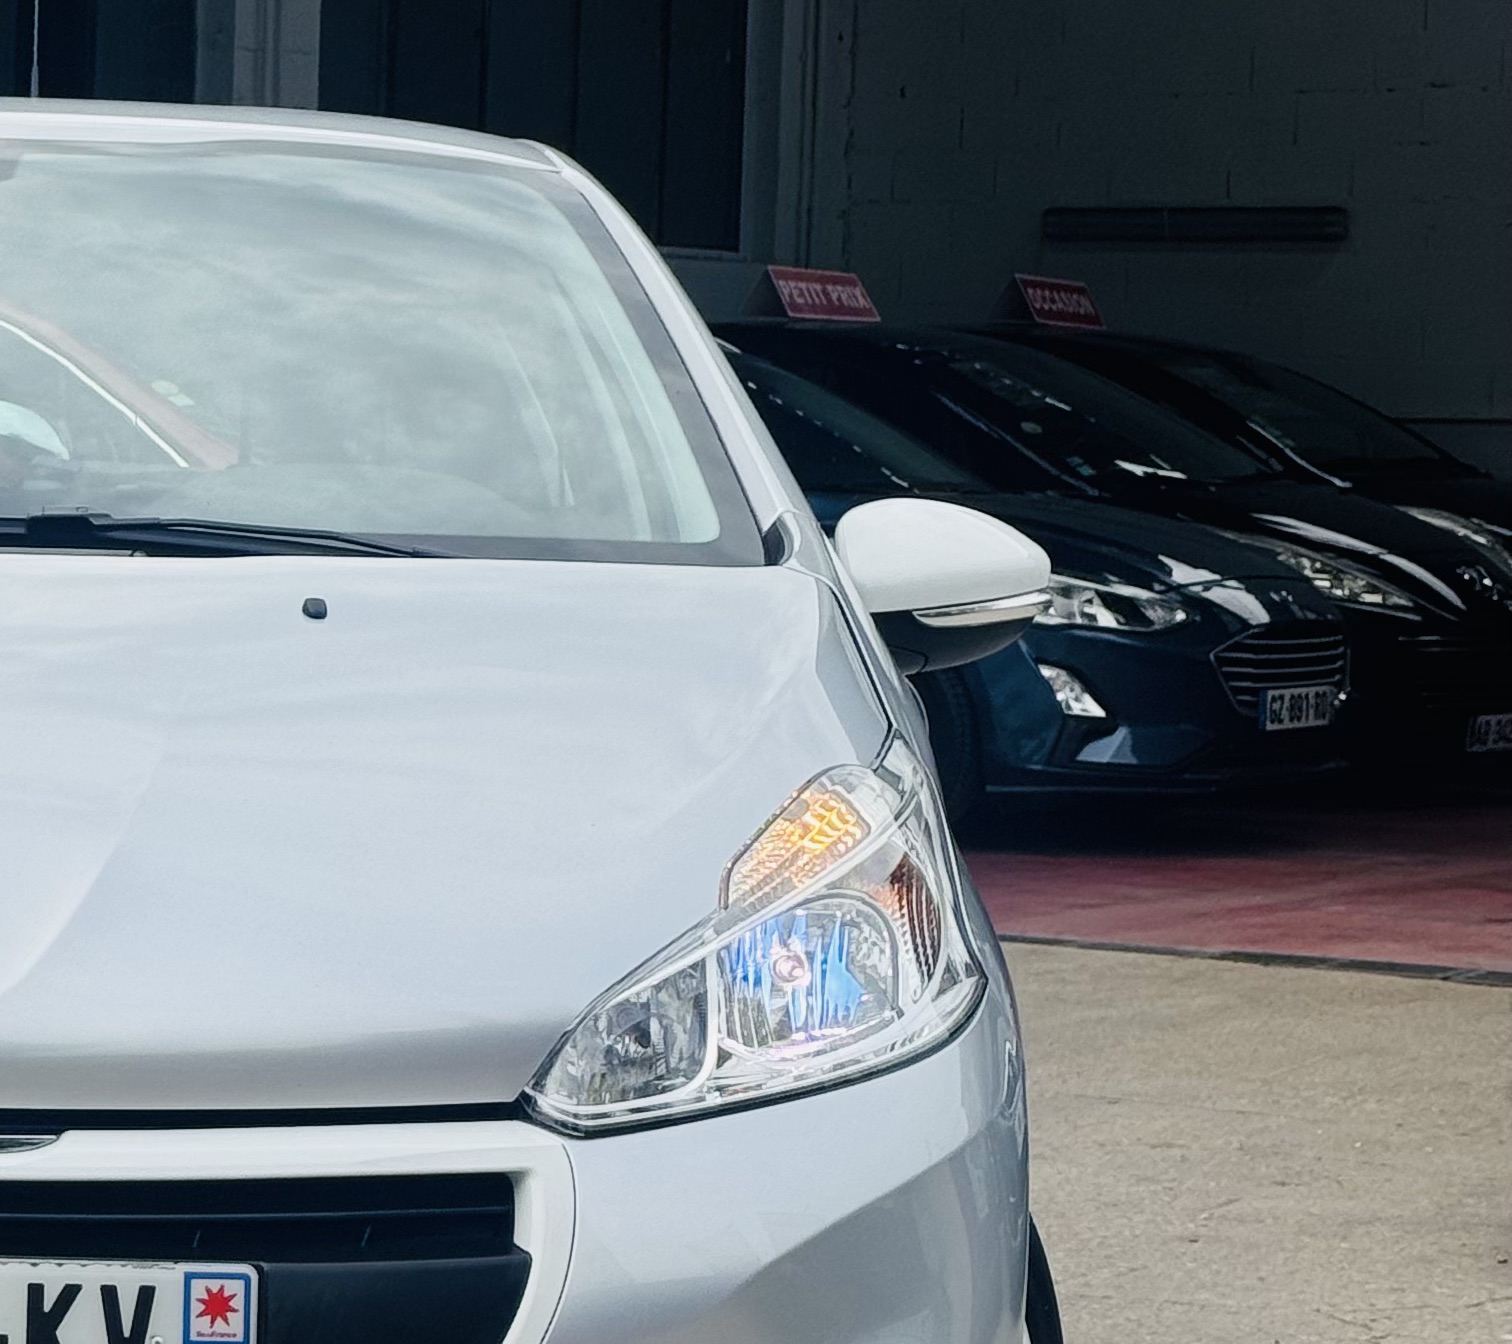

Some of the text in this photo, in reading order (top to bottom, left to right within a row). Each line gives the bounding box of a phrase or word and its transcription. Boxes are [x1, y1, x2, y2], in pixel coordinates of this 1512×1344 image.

[778, 279, 870, 309] PETIT PRIX
[1026, 287, 1096, 316] OCCASION
